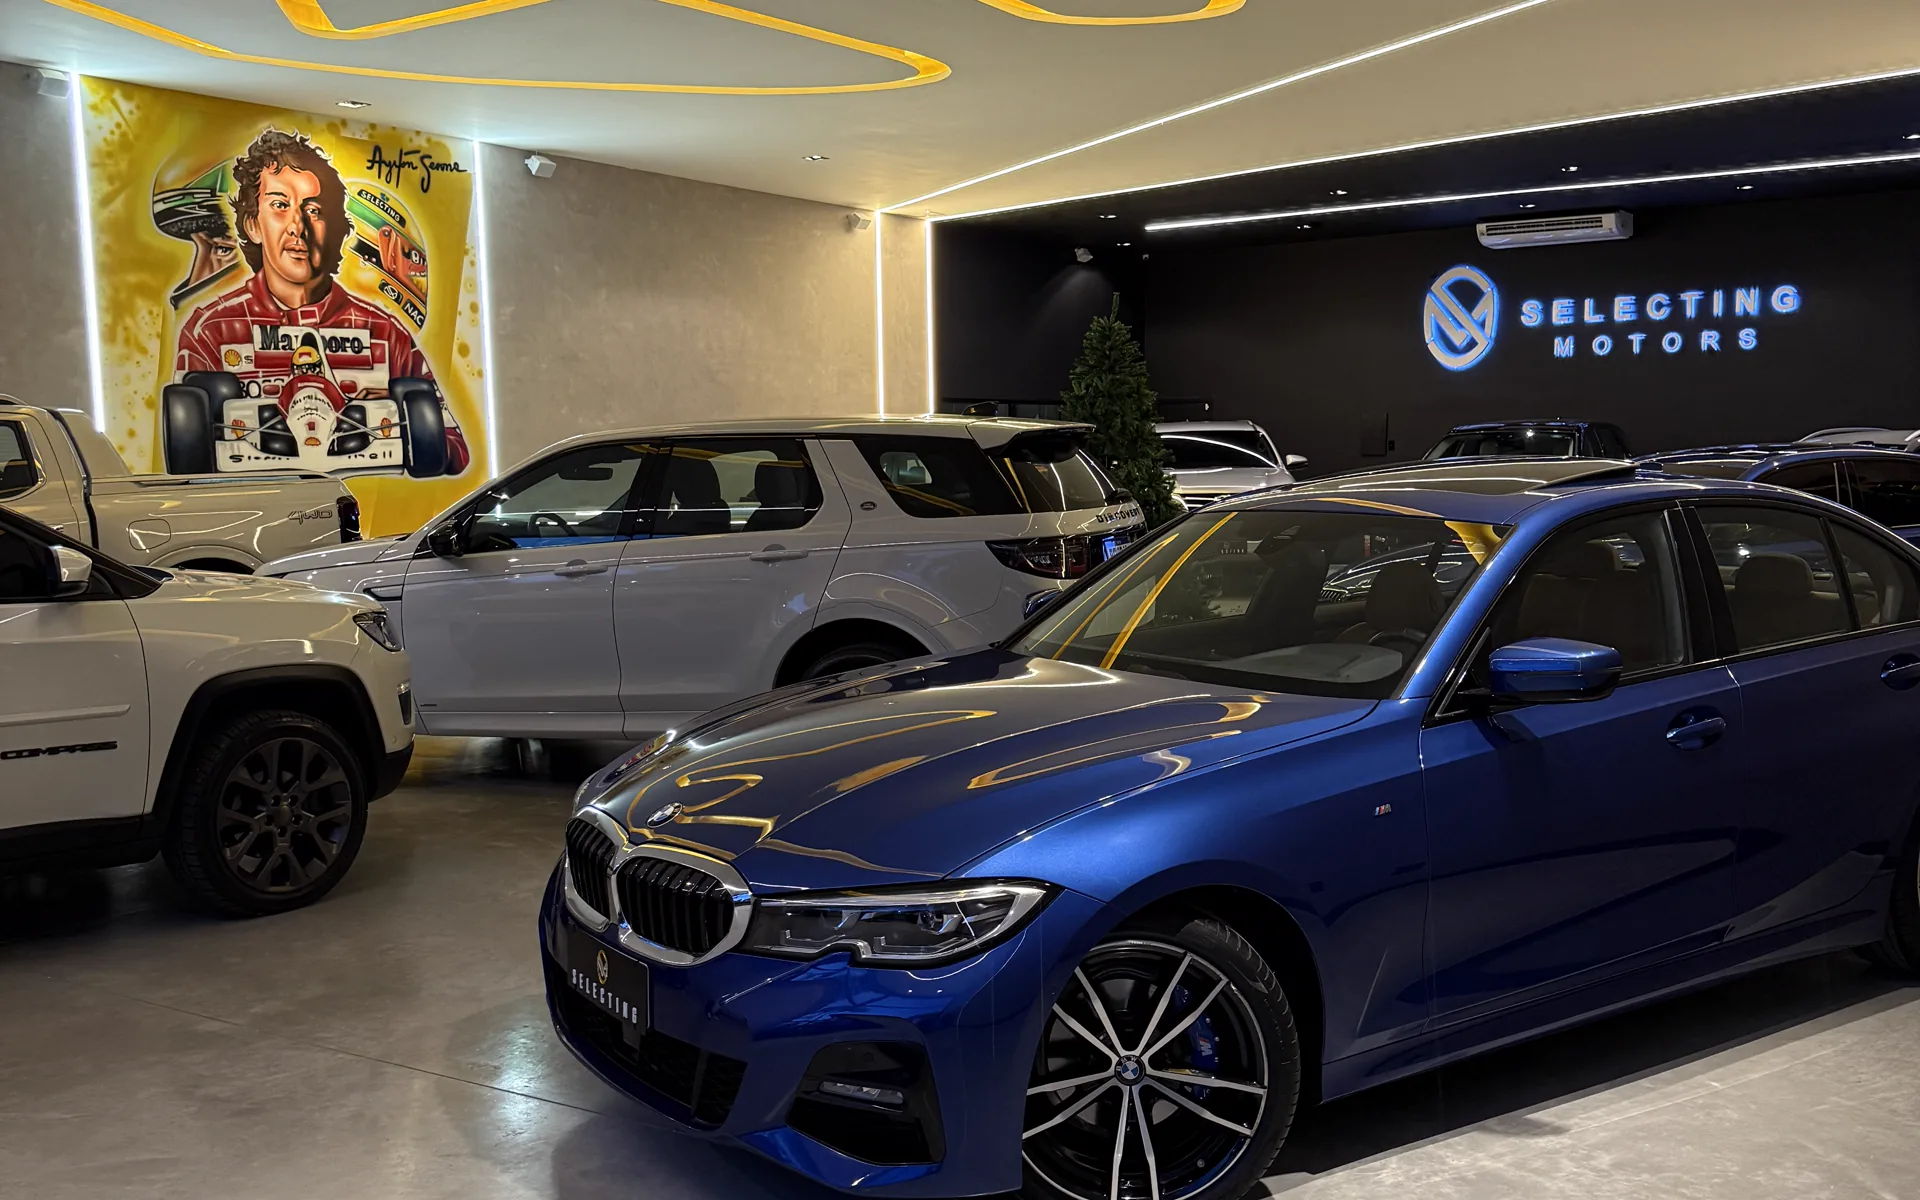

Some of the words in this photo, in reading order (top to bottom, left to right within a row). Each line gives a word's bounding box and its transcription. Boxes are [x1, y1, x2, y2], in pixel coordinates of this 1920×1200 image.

[360, 190, 401, 223] SELECTING
[404, 302, 424, 326] NAC
[1520, 285, 1800, 327] SELECTING
[1553, 328, 1758, 358] MOTORS
[572, 968, 638, 1024] SELECTING
